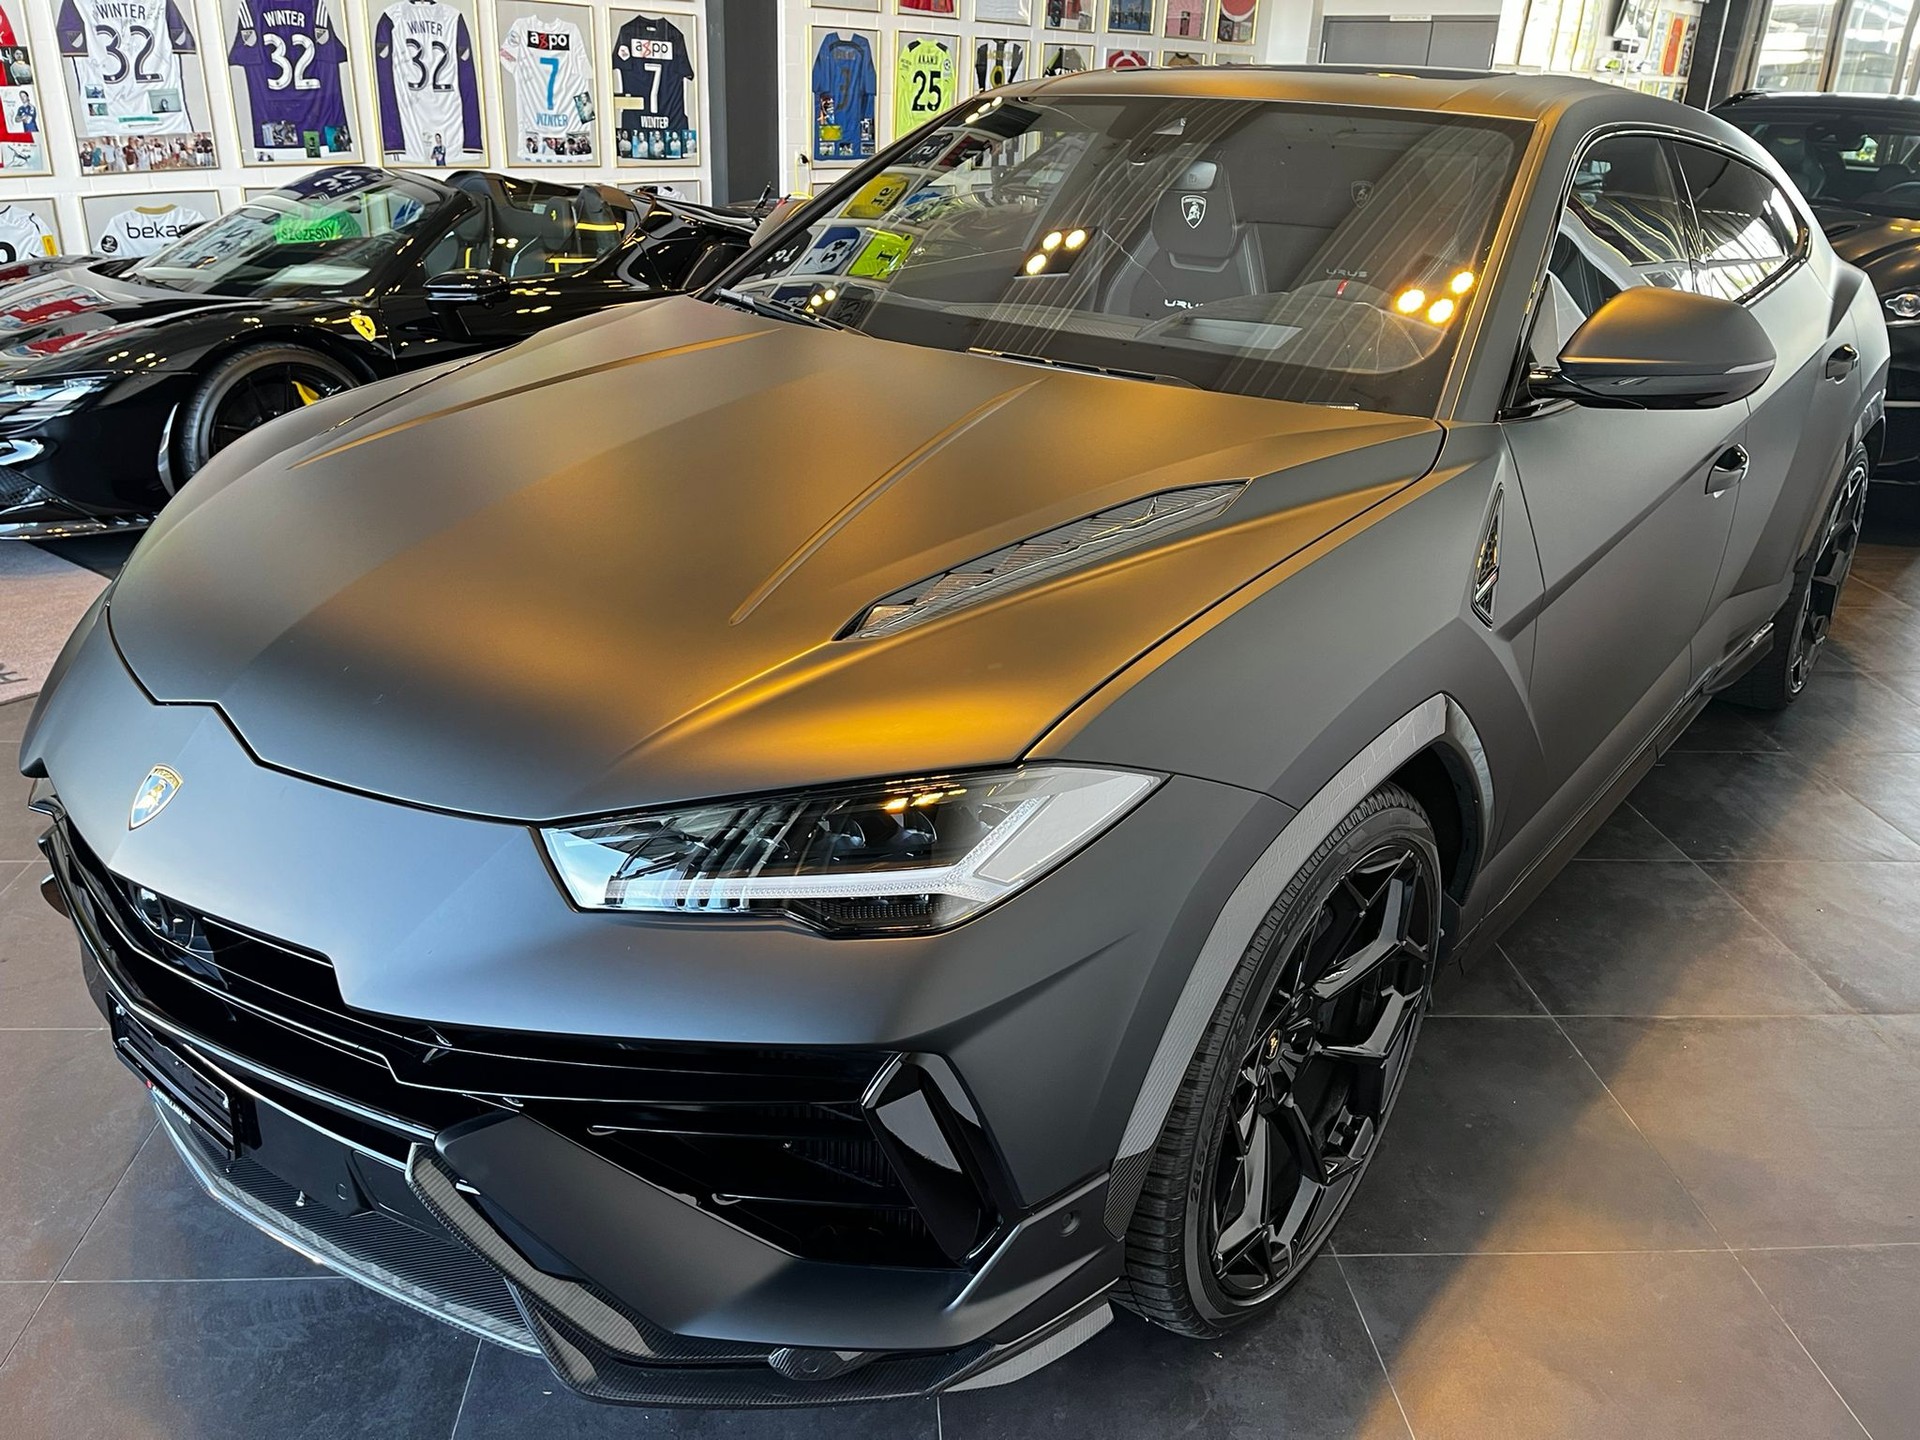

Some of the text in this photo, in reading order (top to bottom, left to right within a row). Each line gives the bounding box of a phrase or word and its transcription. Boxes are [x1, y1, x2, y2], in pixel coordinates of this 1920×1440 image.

[96, 3, 146, 20] WINTER
[263, 10, 305, 28] WINTER
[407, 20, 443, 36] WINTER
[96, 25, 164, 84] 32
[263, 33, 321, 91] 32
[406, 38, 454, 93] 32
[539, 57, 559, 111] 7
[644, 62, 662, 113] 7
[911, 70, 941, 112] 25
[536, 113, 568, 128] WINTER
[640, 115, 669, 129] WINTER
[1326, 268, 1368, 278] URUS
[1164, 299, 1204, 309] URU
